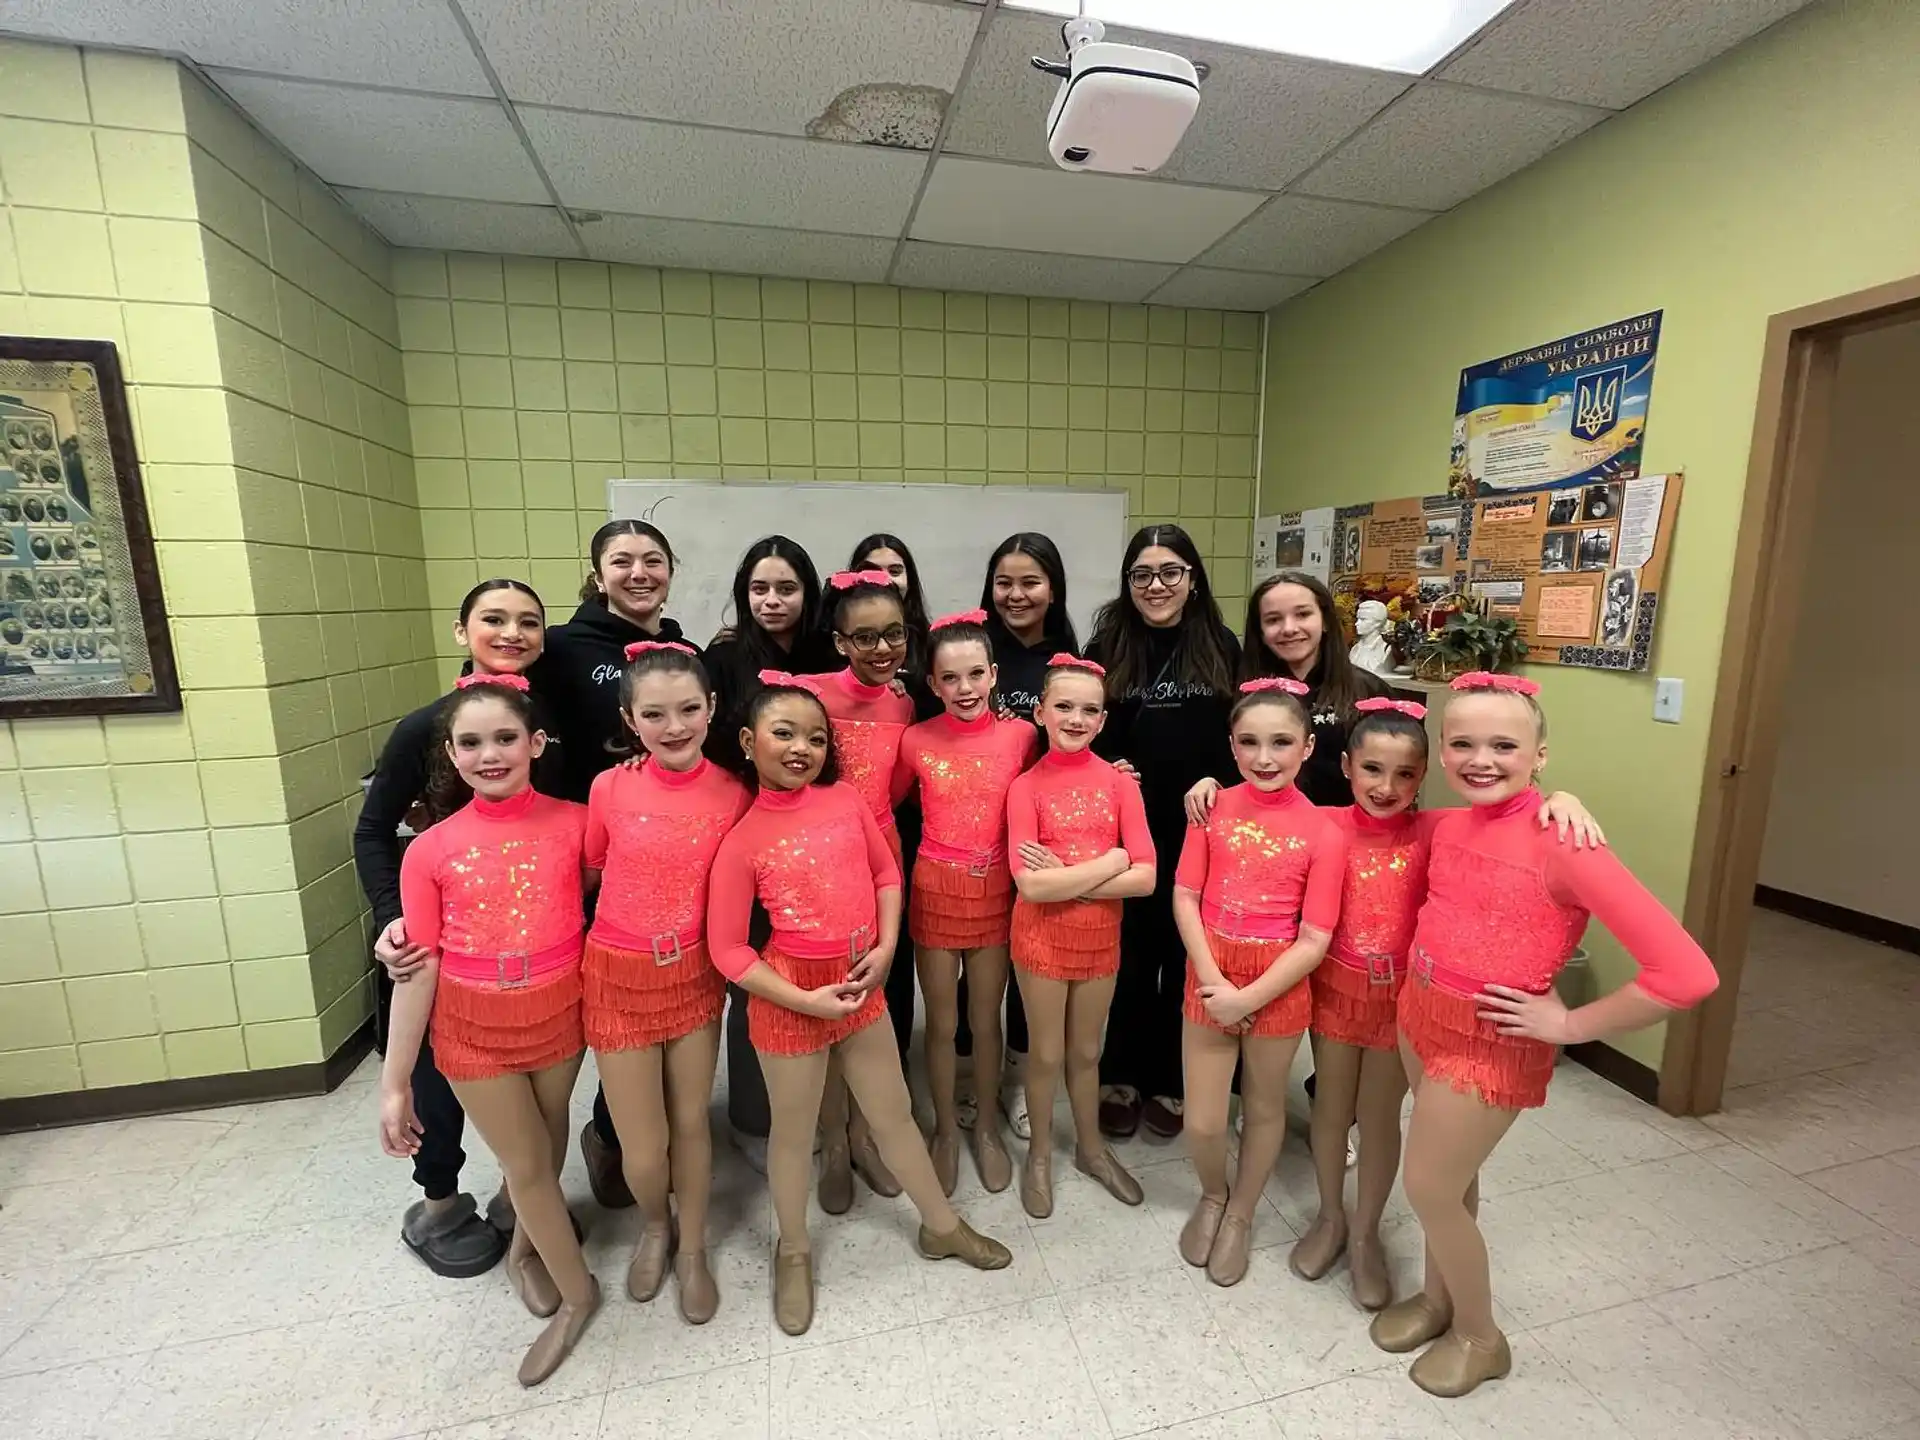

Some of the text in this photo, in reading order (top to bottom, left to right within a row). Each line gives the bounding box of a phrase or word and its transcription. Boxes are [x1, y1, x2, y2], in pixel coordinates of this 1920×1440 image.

[1574, 317, 1652, 349] СИМВОЛИ
[1547, 336, 1649, 376] УКРАЇНИ
[592, 664, 622, 685] Gla
[1155, 681, 1213, 700] Slippers
